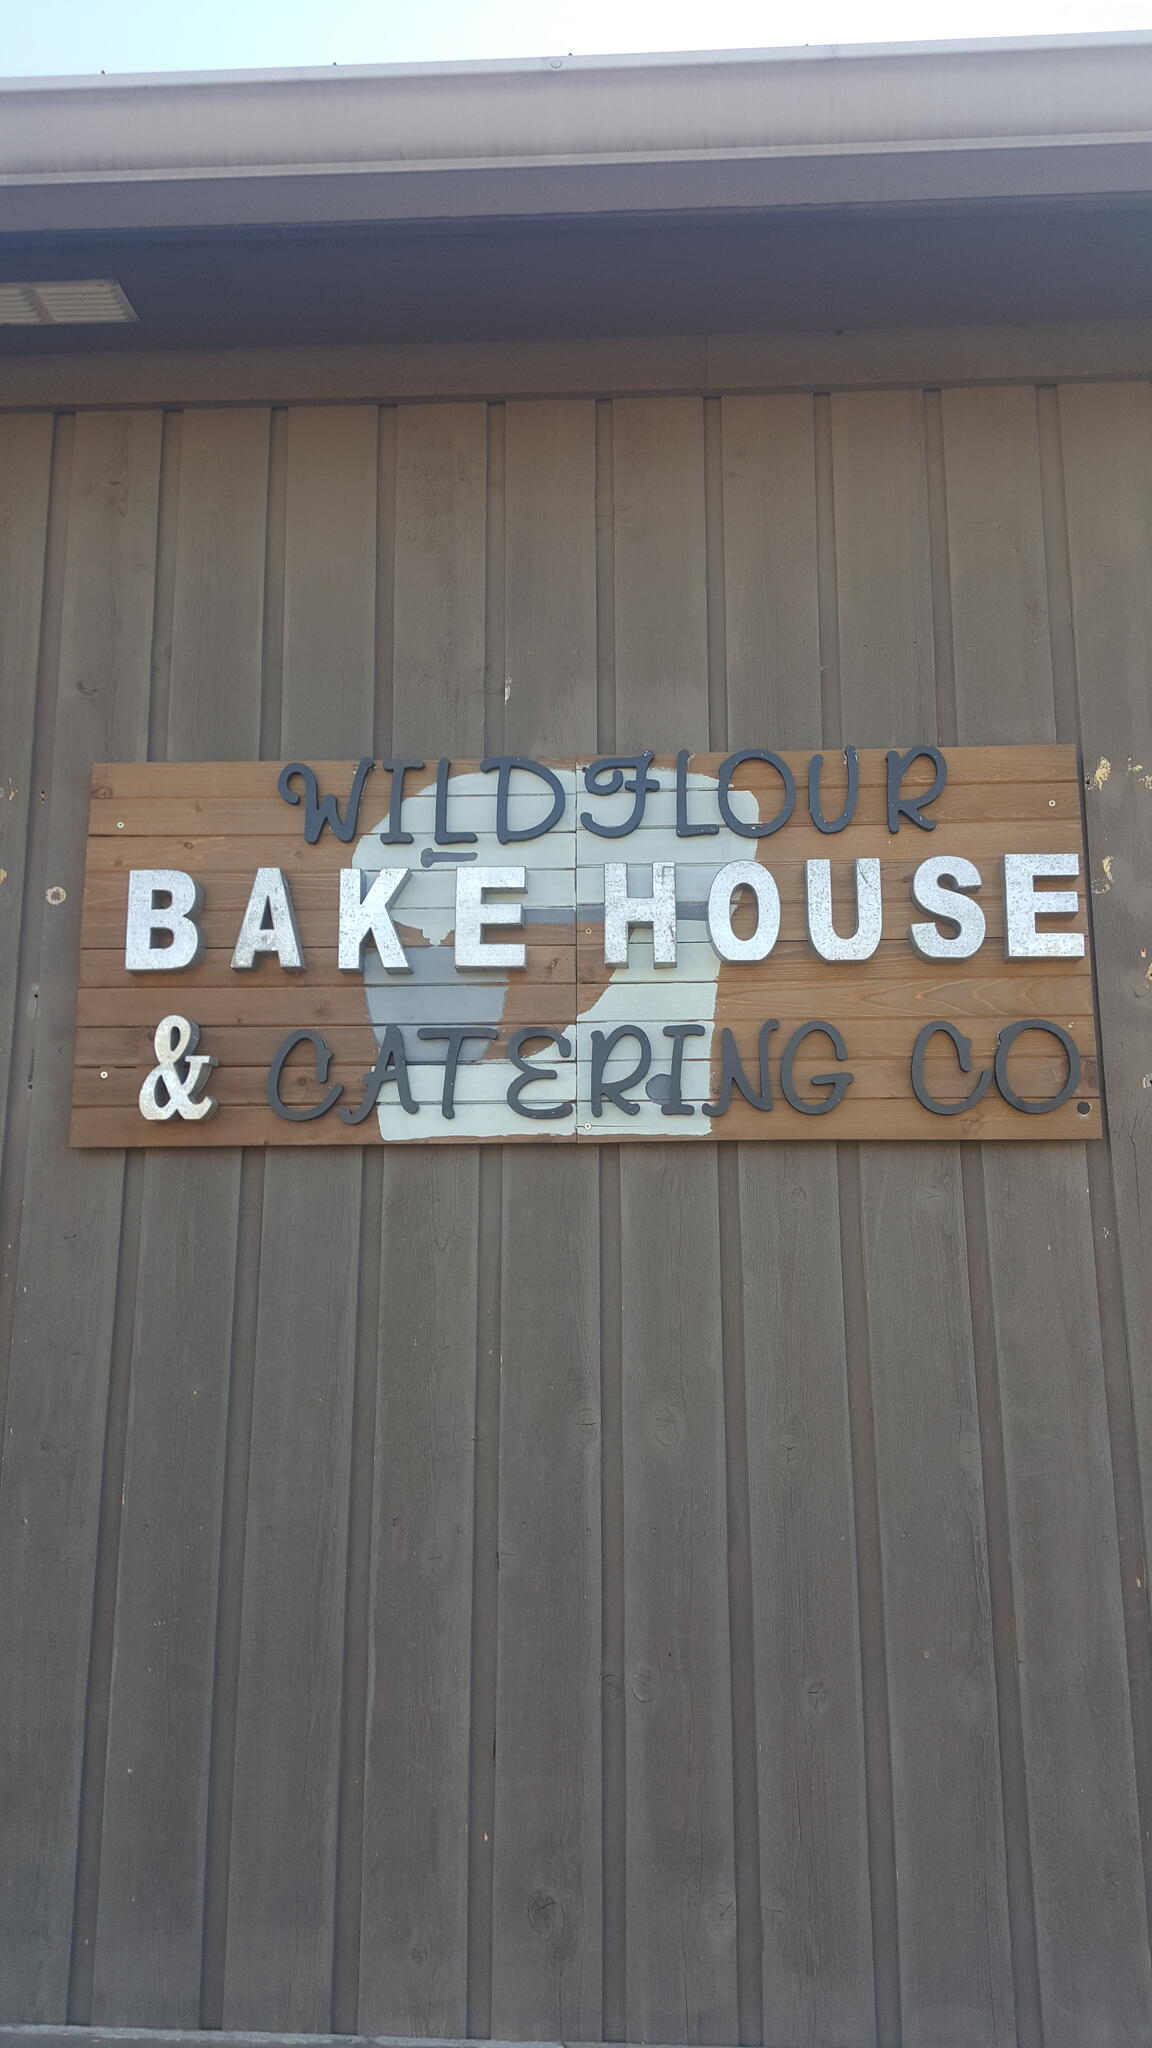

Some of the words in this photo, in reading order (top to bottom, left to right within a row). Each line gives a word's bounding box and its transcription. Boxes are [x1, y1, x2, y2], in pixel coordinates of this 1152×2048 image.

[125, 866, 527, 975] BAKE
[604, 854, 1085, 968] HOUSE
[139, 1015, 218, 1123] &
[268, 1019, 854, 1125] CATERING
